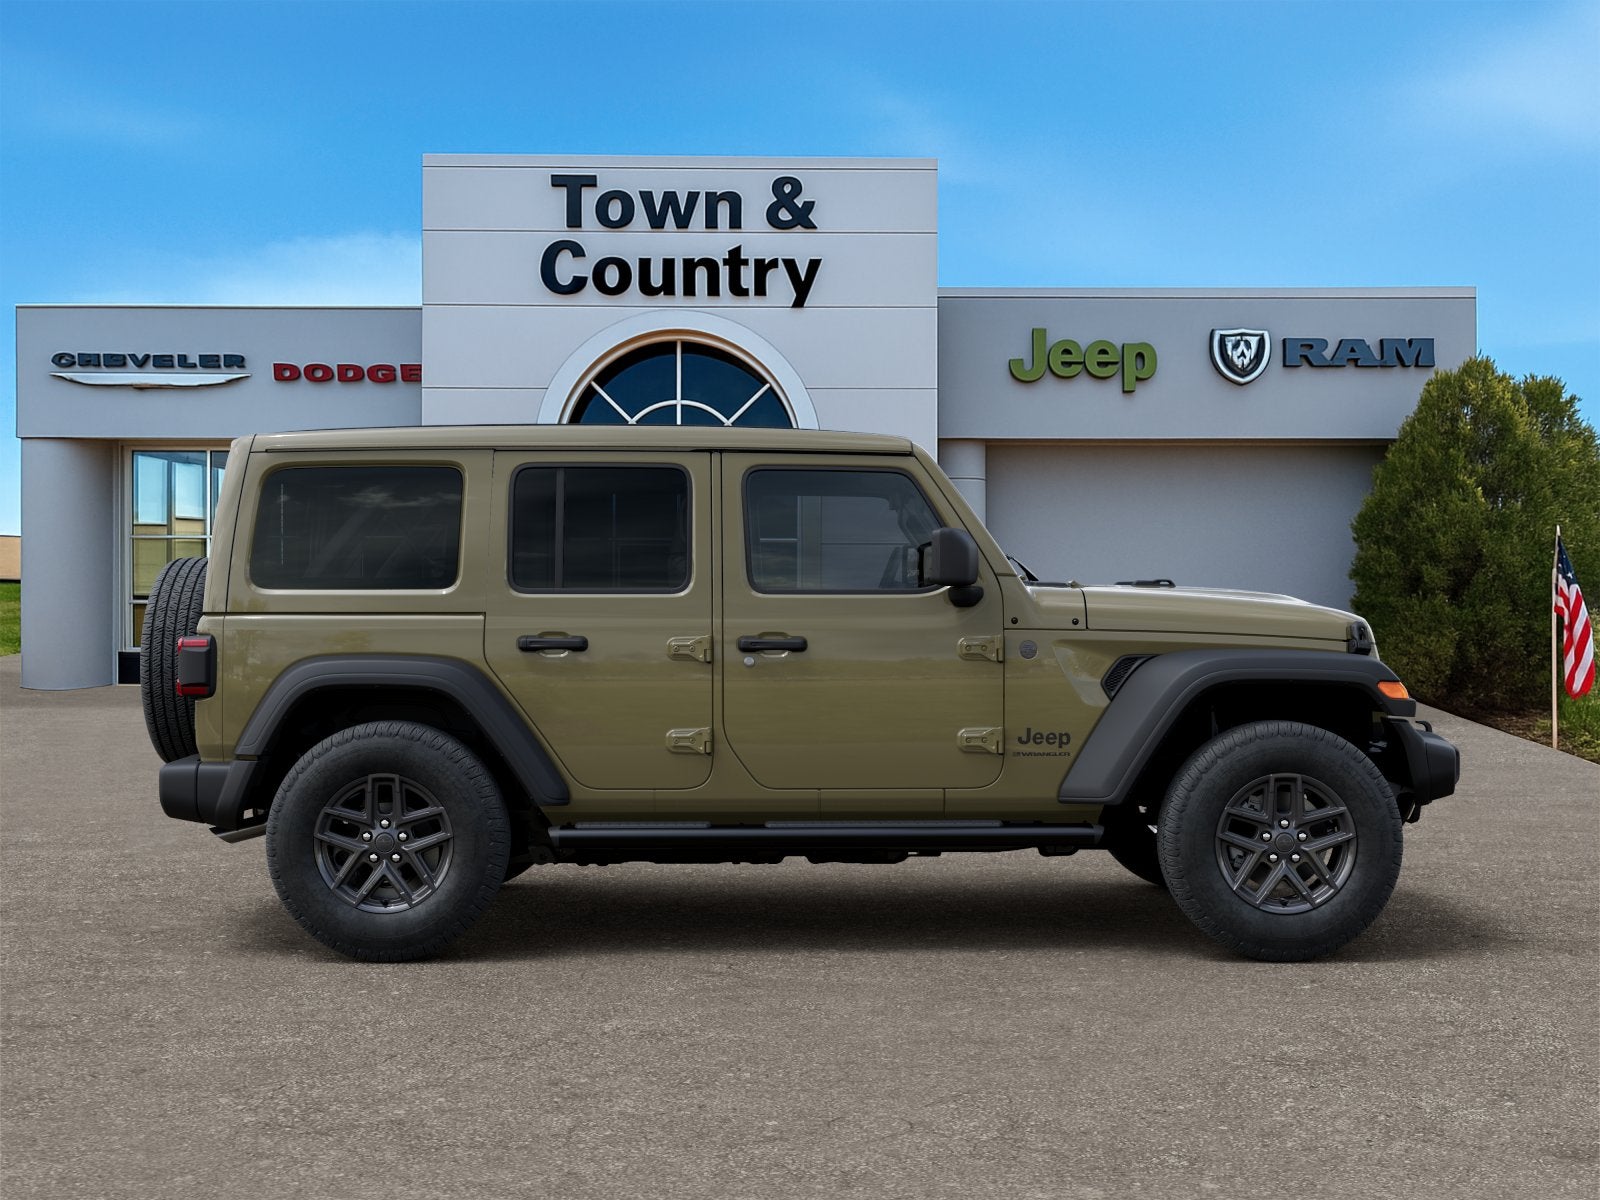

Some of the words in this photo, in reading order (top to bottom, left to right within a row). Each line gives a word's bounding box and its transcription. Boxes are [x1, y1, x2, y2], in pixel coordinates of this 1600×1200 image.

[550, 174, 743, 230] Town
[765, 176, 818, 230] &
[540, 239, 822, 308] Country
[273, 362, 422, 383] DODGE
[1009, 328, 1158, 393] Jeep
[1283, 337, 1436, 368] RAM
[1017, 727, 1071, 749] Jeep
